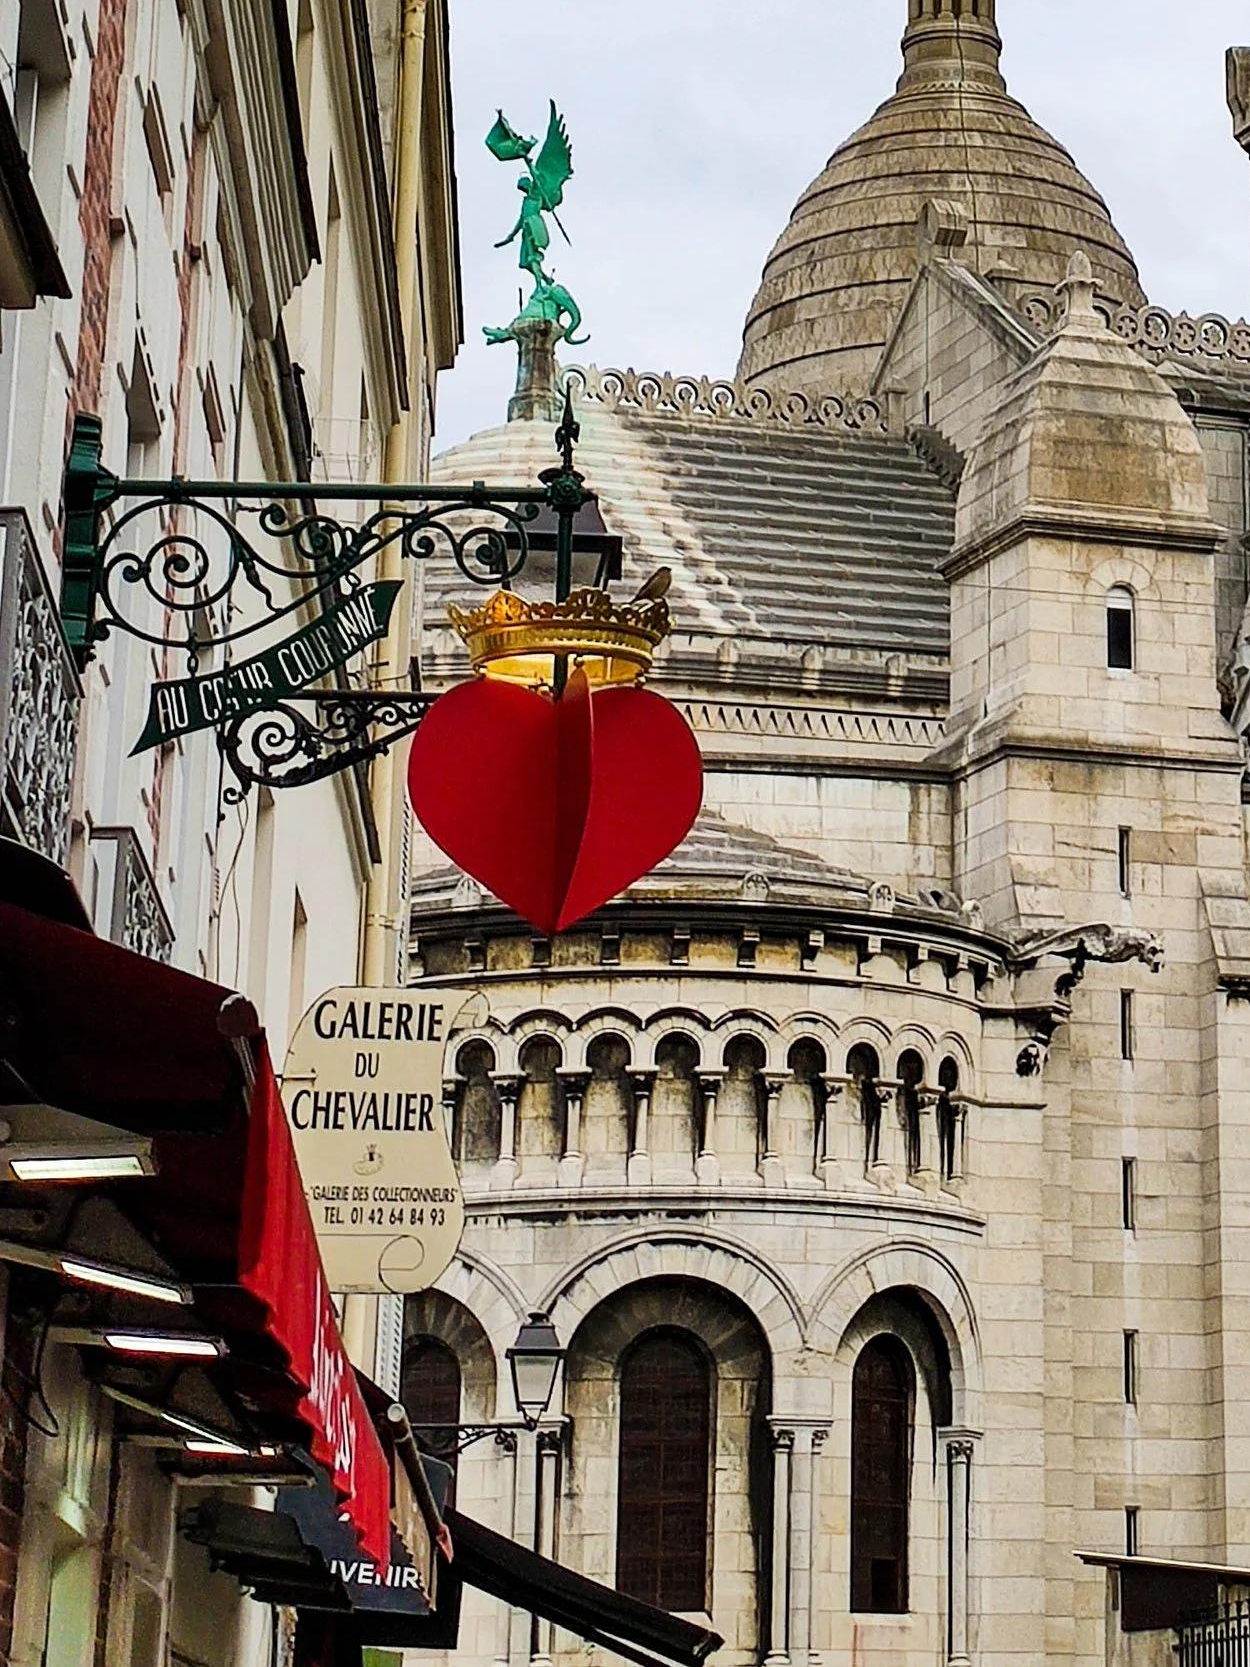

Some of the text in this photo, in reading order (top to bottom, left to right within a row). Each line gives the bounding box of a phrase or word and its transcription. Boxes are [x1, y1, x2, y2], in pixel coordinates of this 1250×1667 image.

[156, 686, 189, 733] AU
[314, 1000, 443, 1042] GALERIE
[355, 1052, 379, 1078] DU
[292, 1089, 434, 1131] CHEVALIER
[352, 1186, 369, 1201] DES
[351, 1207, 363, 1224] 01
[368, 1208, 383, 1225] 42
[389, 1208, 403, 1225] 64
[410, 1208, 424, 1225] 84
[430, 1208, 445, 1226] 93
